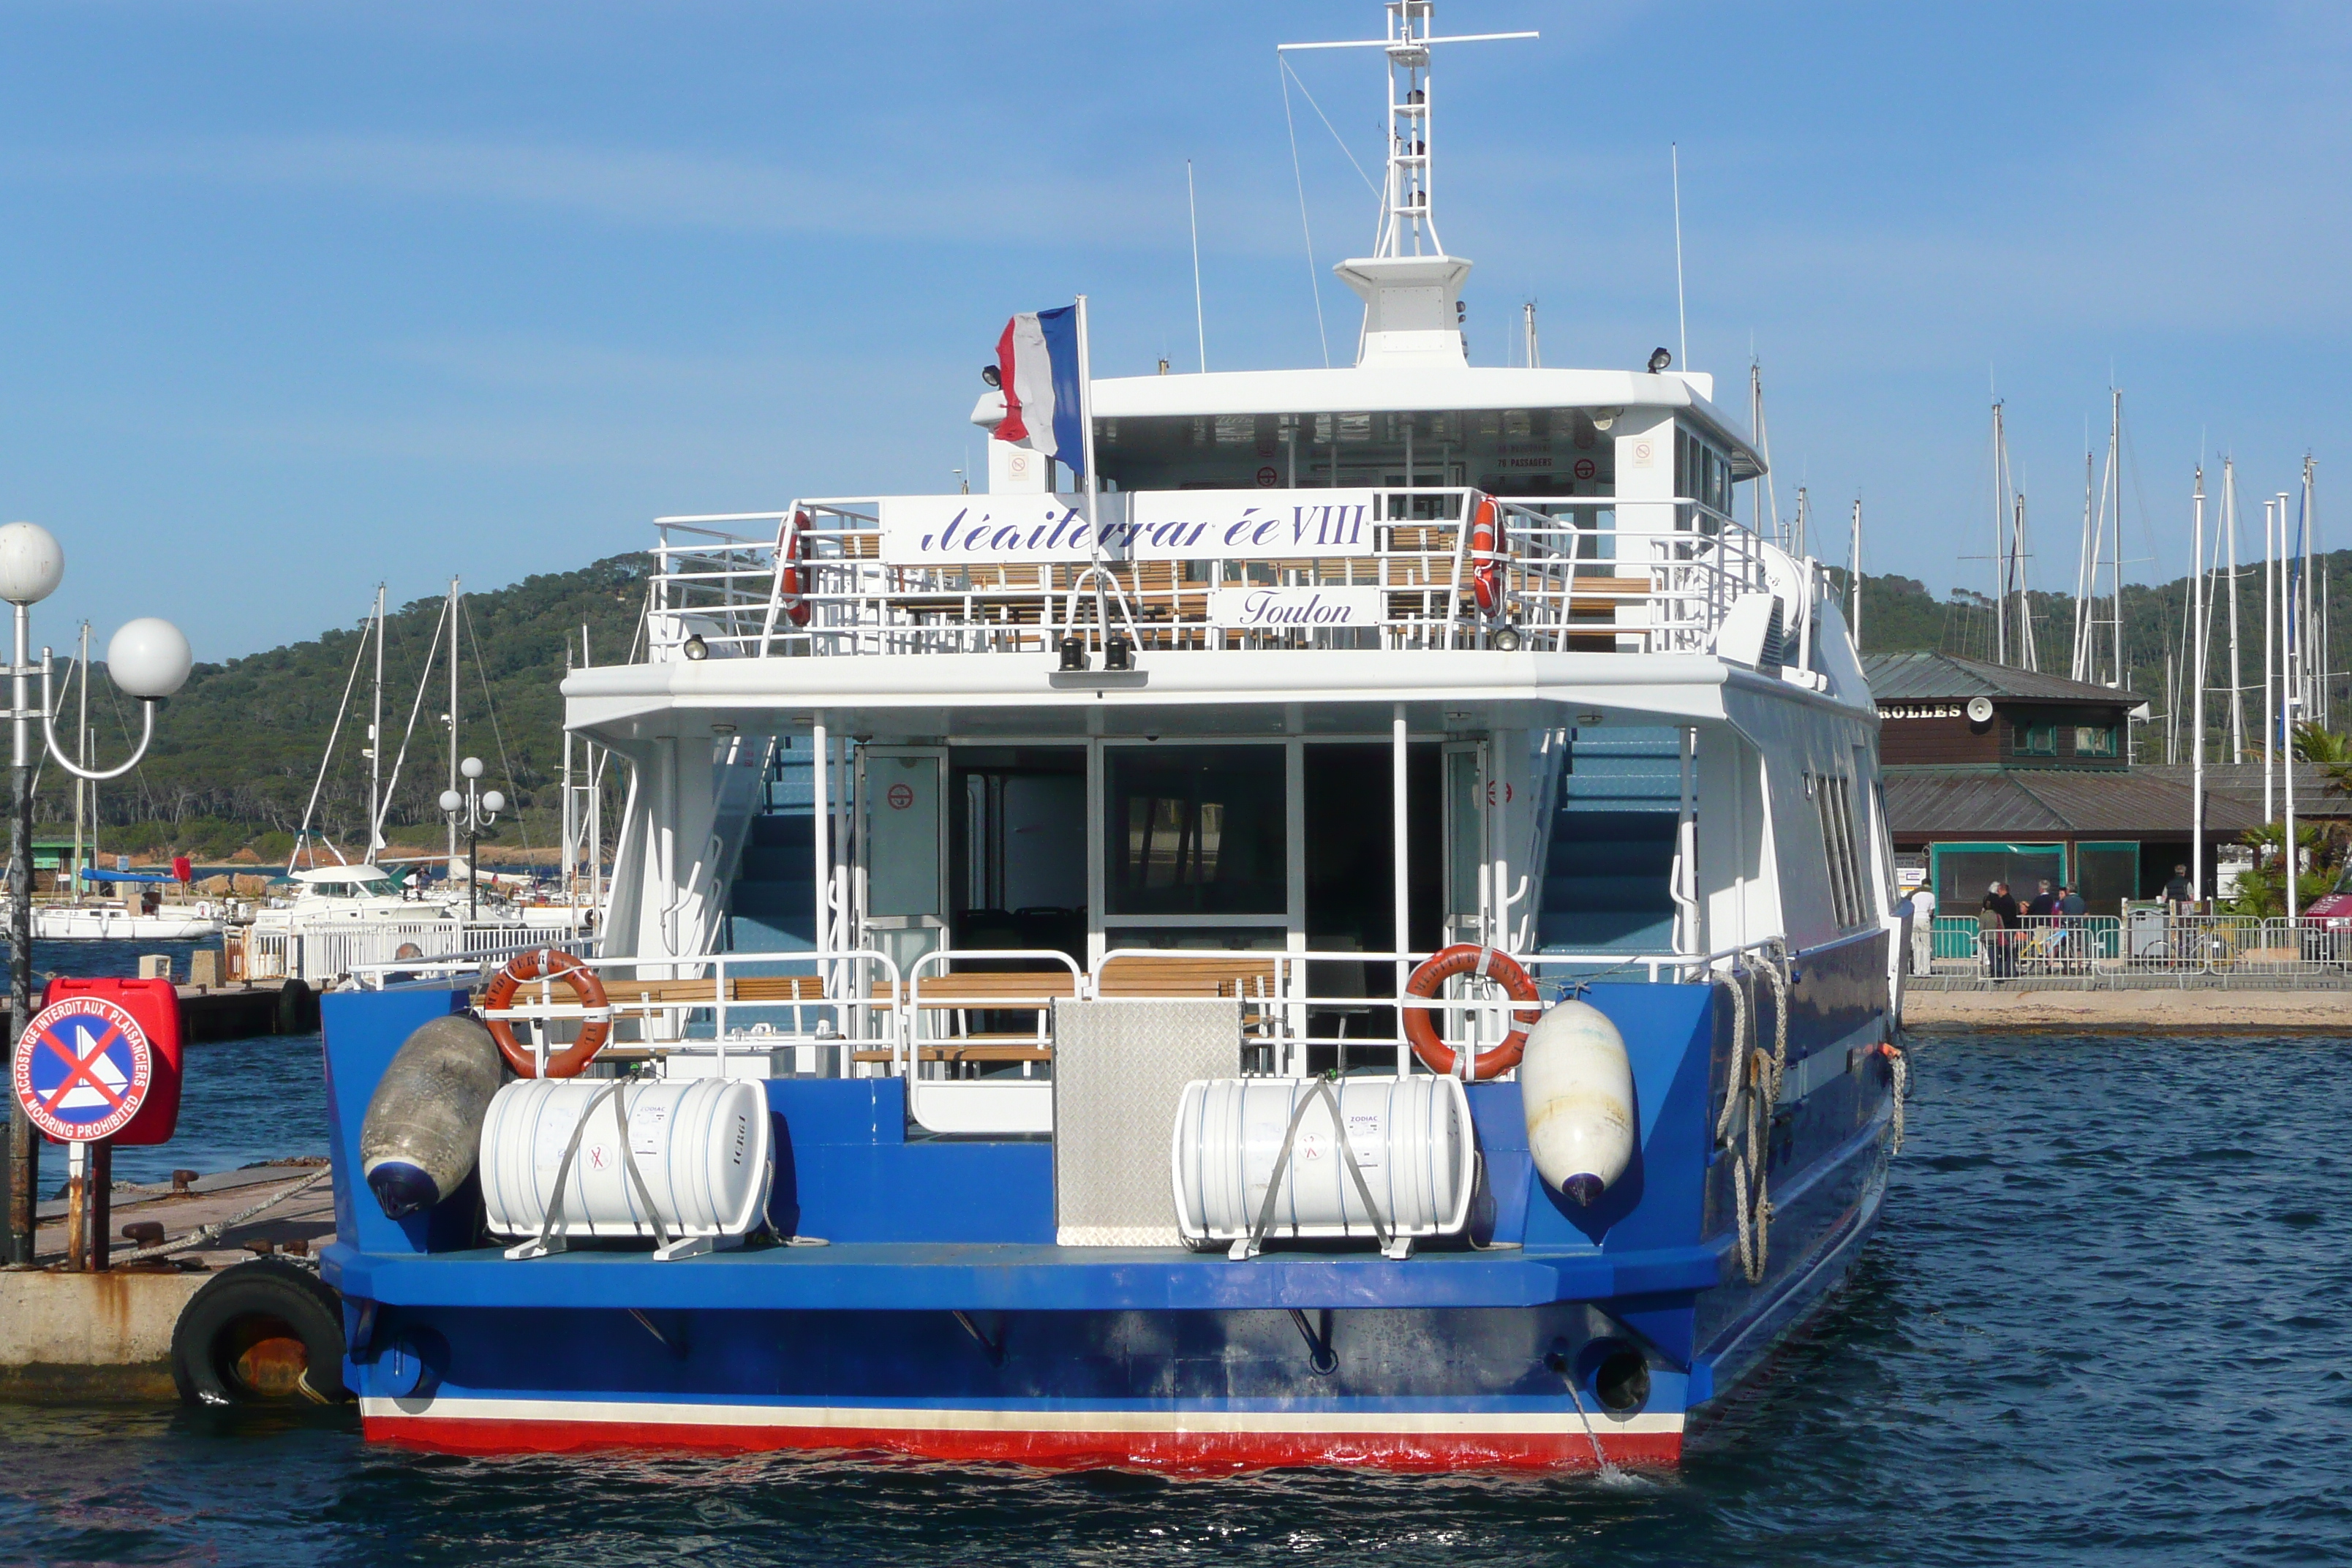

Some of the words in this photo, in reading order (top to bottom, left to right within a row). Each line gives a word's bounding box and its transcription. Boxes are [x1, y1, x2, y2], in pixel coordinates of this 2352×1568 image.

[1510, 458, 1552, 467] PASSAGERS
[1292, 505, 1368, 546] VIII
[1240, 590, 1354, 625] Toulon
[18, 1028, 40, 1096] ACCOSTAGE
[35, 1001, 82, 1031] INTERDIT
[83, 1002, 106, 1017] AUX
[109, 1010, 148, 1088] PLAISANCIERS
[26, 1098, 74, 1138] MOORING
[77, 1094, 138, 1138] PROHIBITED
